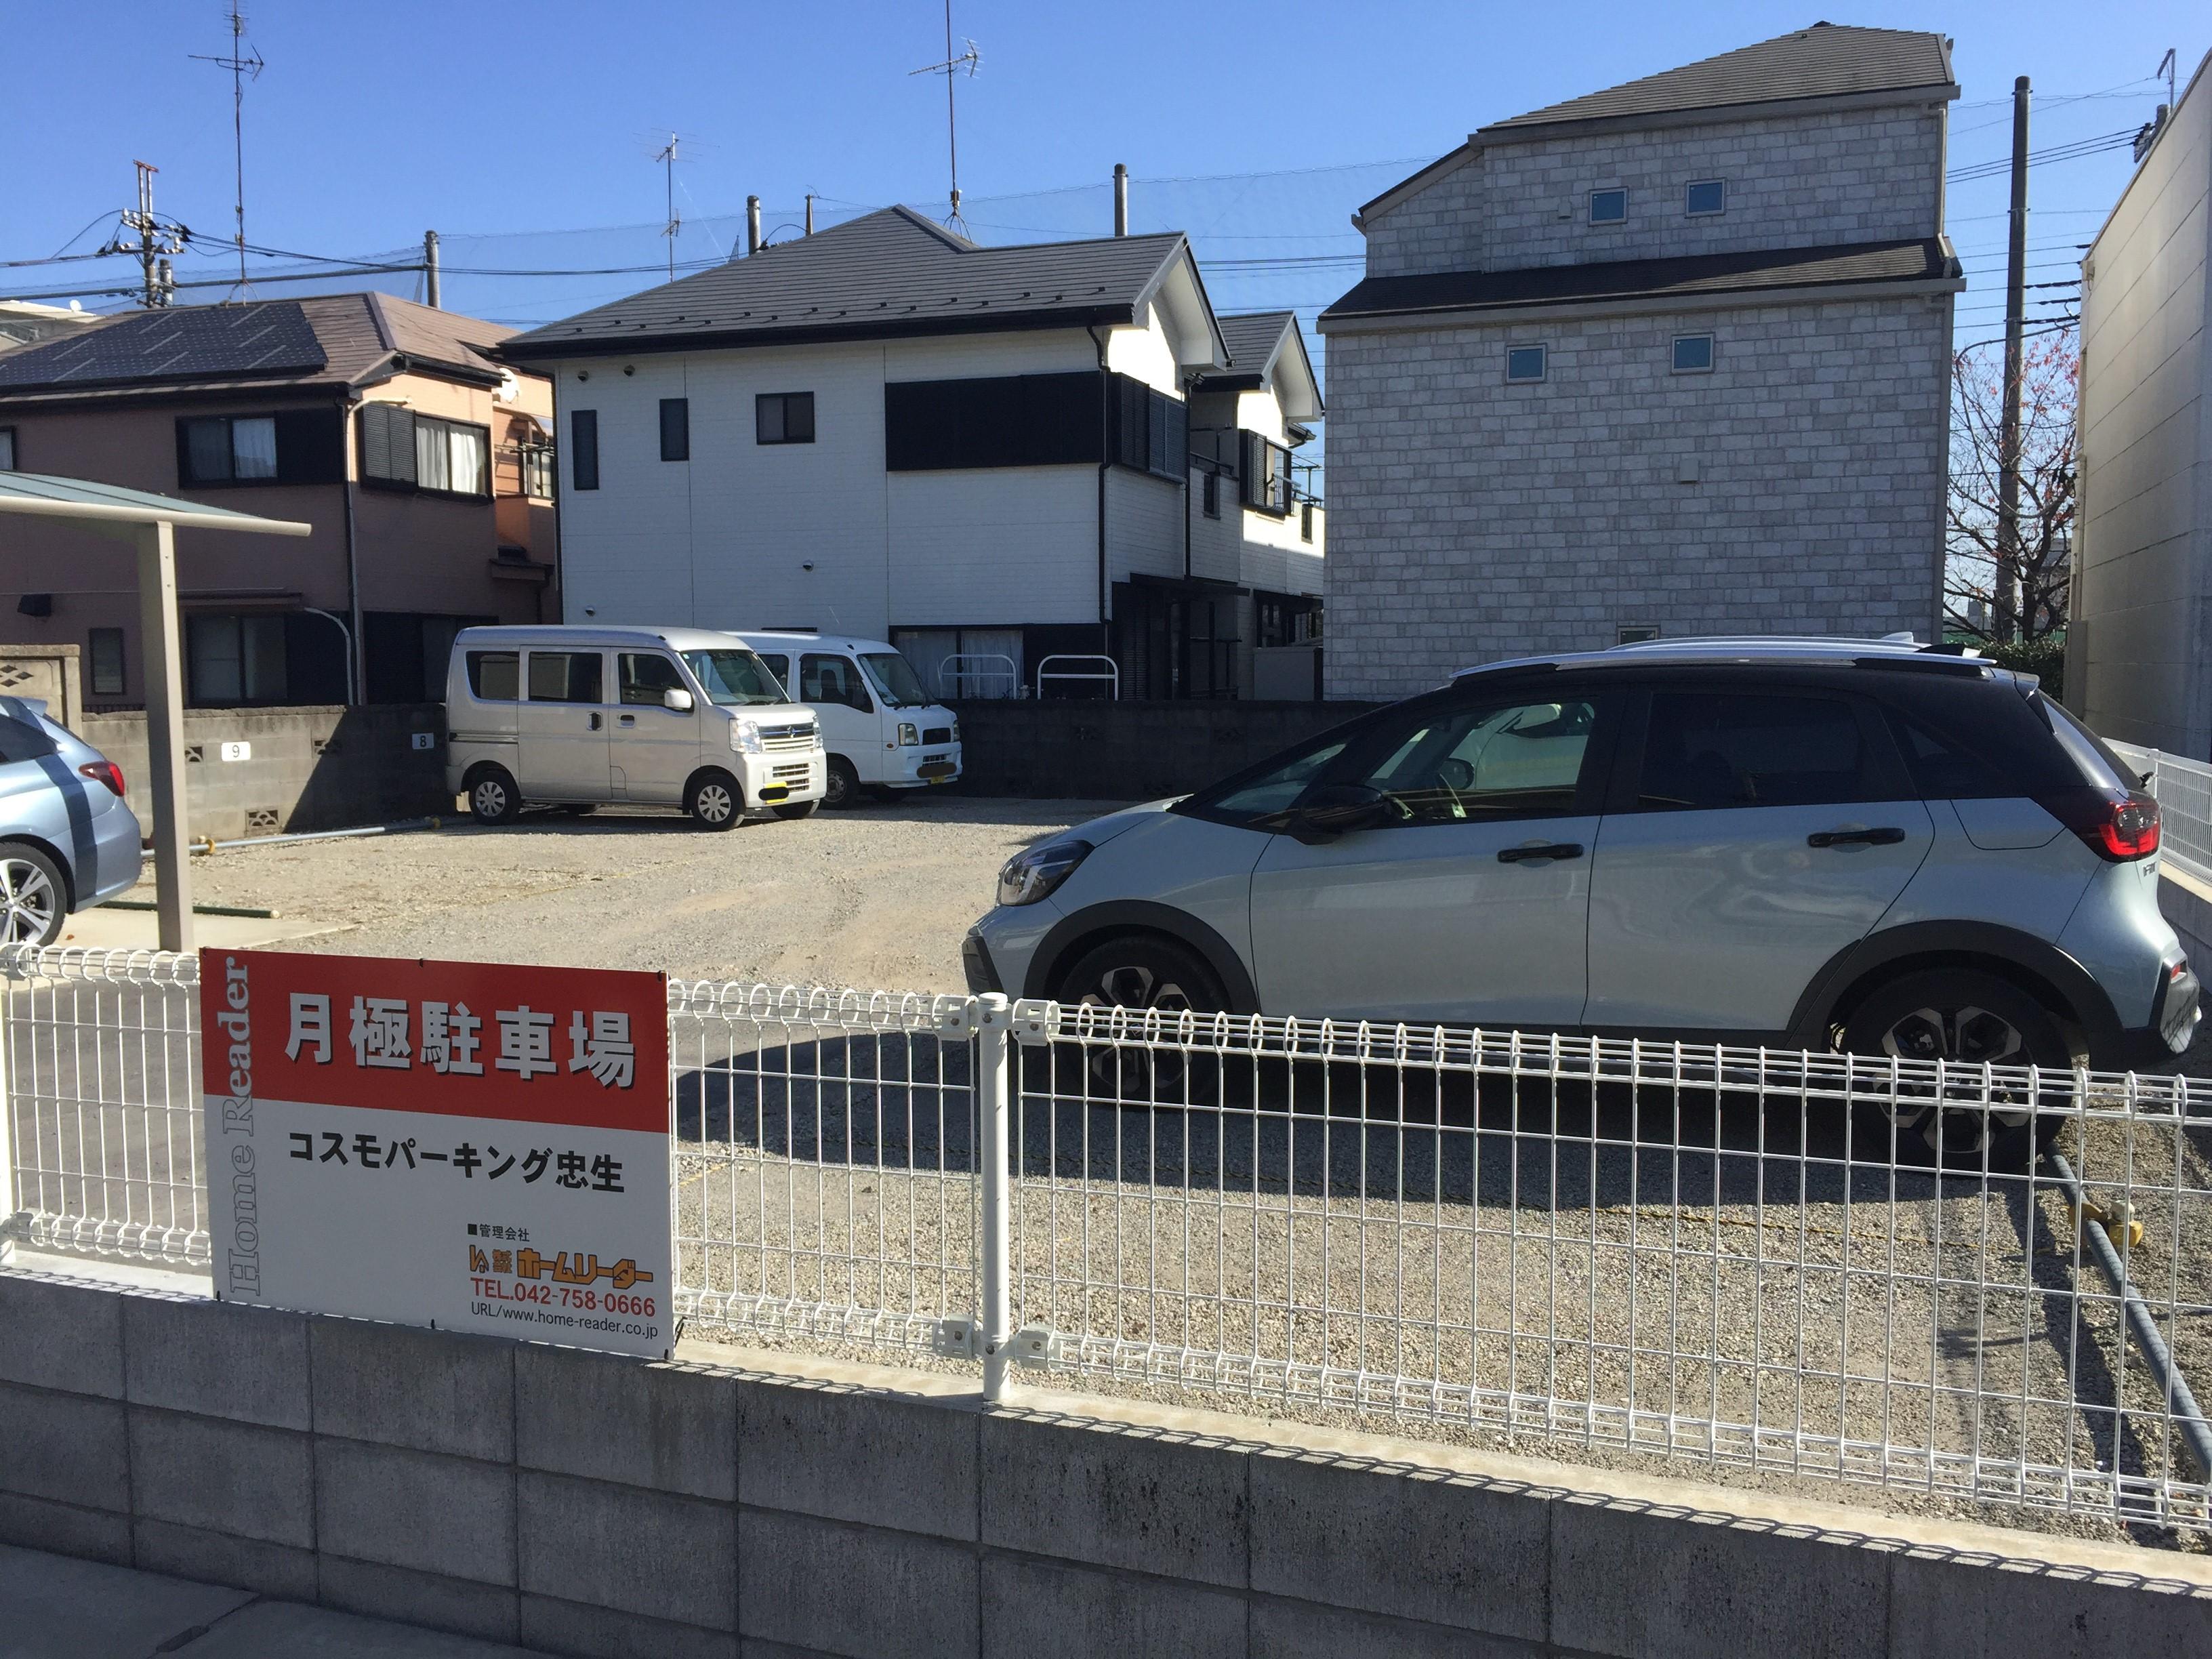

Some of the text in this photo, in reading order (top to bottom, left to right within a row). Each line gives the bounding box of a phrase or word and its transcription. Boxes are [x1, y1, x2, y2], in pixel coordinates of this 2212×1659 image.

[232, 745, 240, 758] 9
[420, 735, 427, 747] 8
[285, 992, 636, 1089] 月極駐車場
[217, 956, 261, 1296] Home Reader
[289, 1132, 625, 1193] コスモパーキング忠生
[516, 1248, 653, 1290] ホームリーダー
[470, 1277, 656, 1317] TEL.042-758-0666
[471, 1301, 658, 1339] URL/www.home-reader.co.jp
